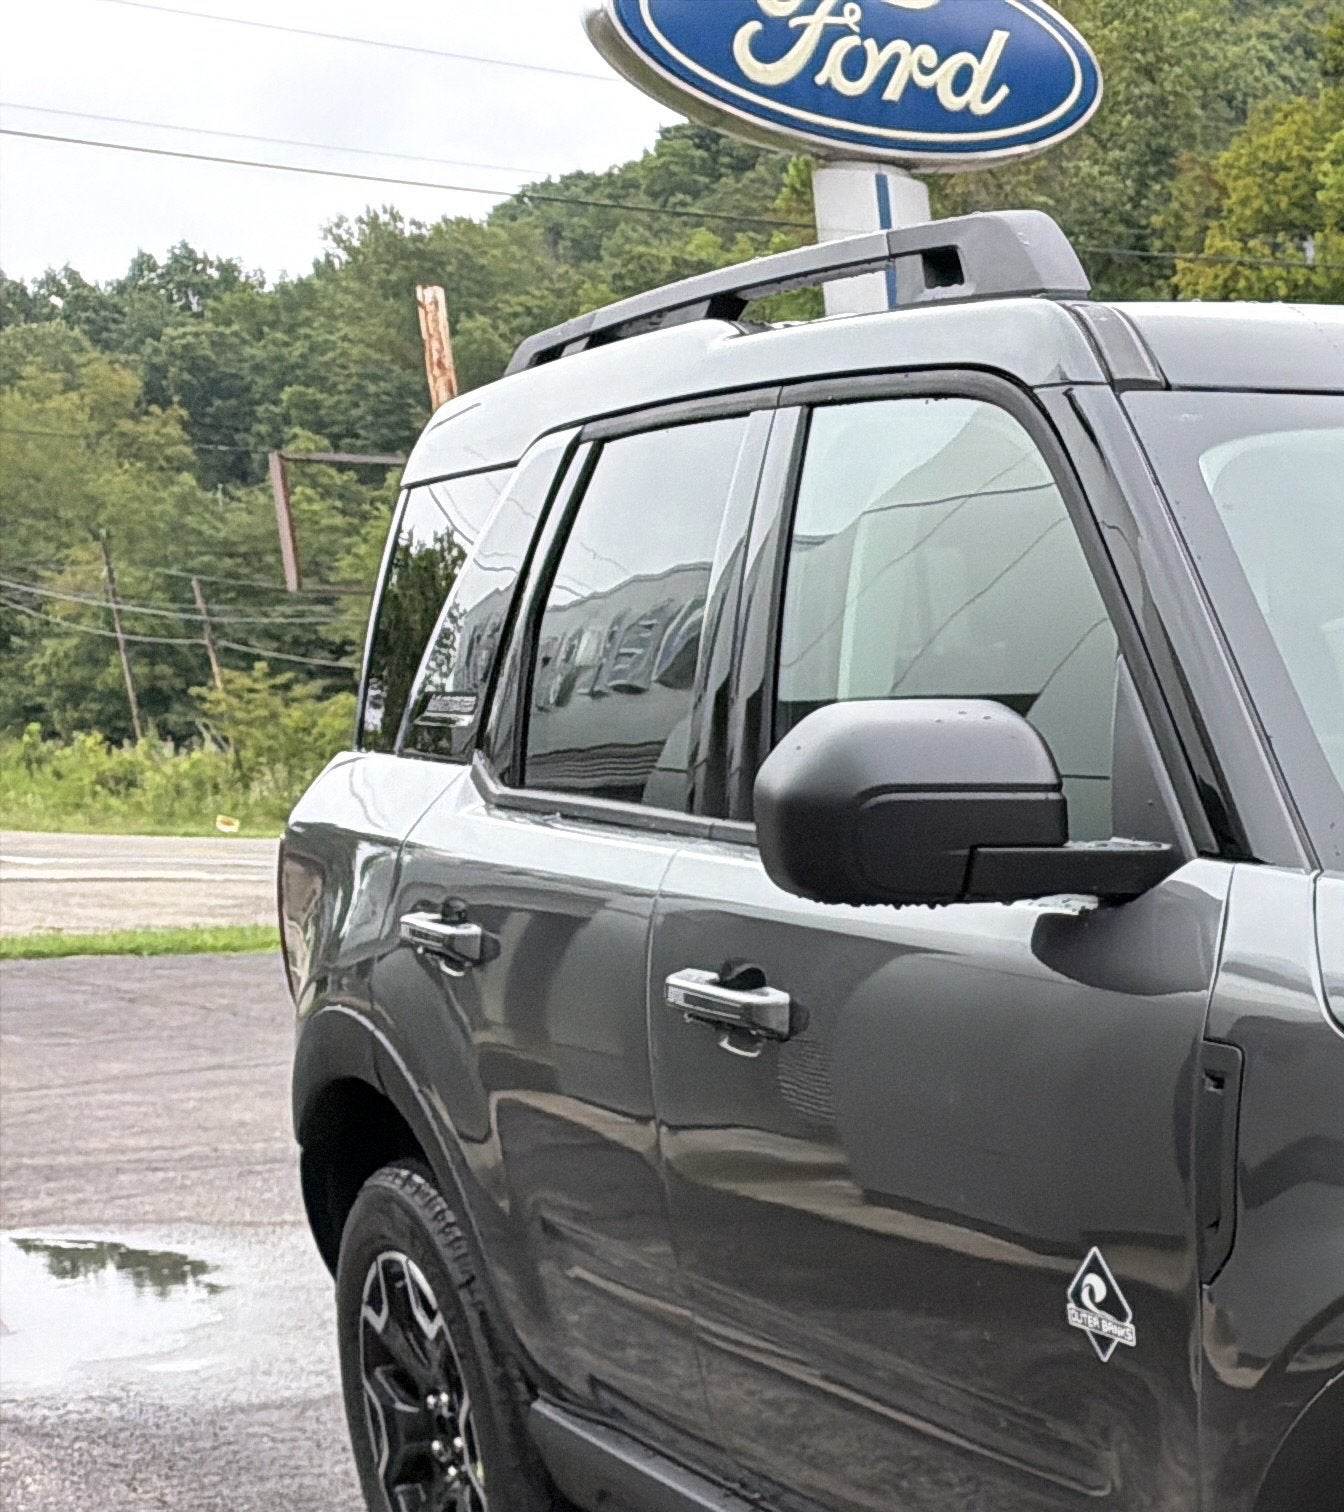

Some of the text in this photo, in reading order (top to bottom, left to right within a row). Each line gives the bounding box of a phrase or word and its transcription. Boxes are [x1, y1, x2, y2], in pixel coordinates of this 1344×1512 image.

[732, 0, 1011, 116] Ford
[1071, 1309, 1133, 1341] OUTER BANKS
